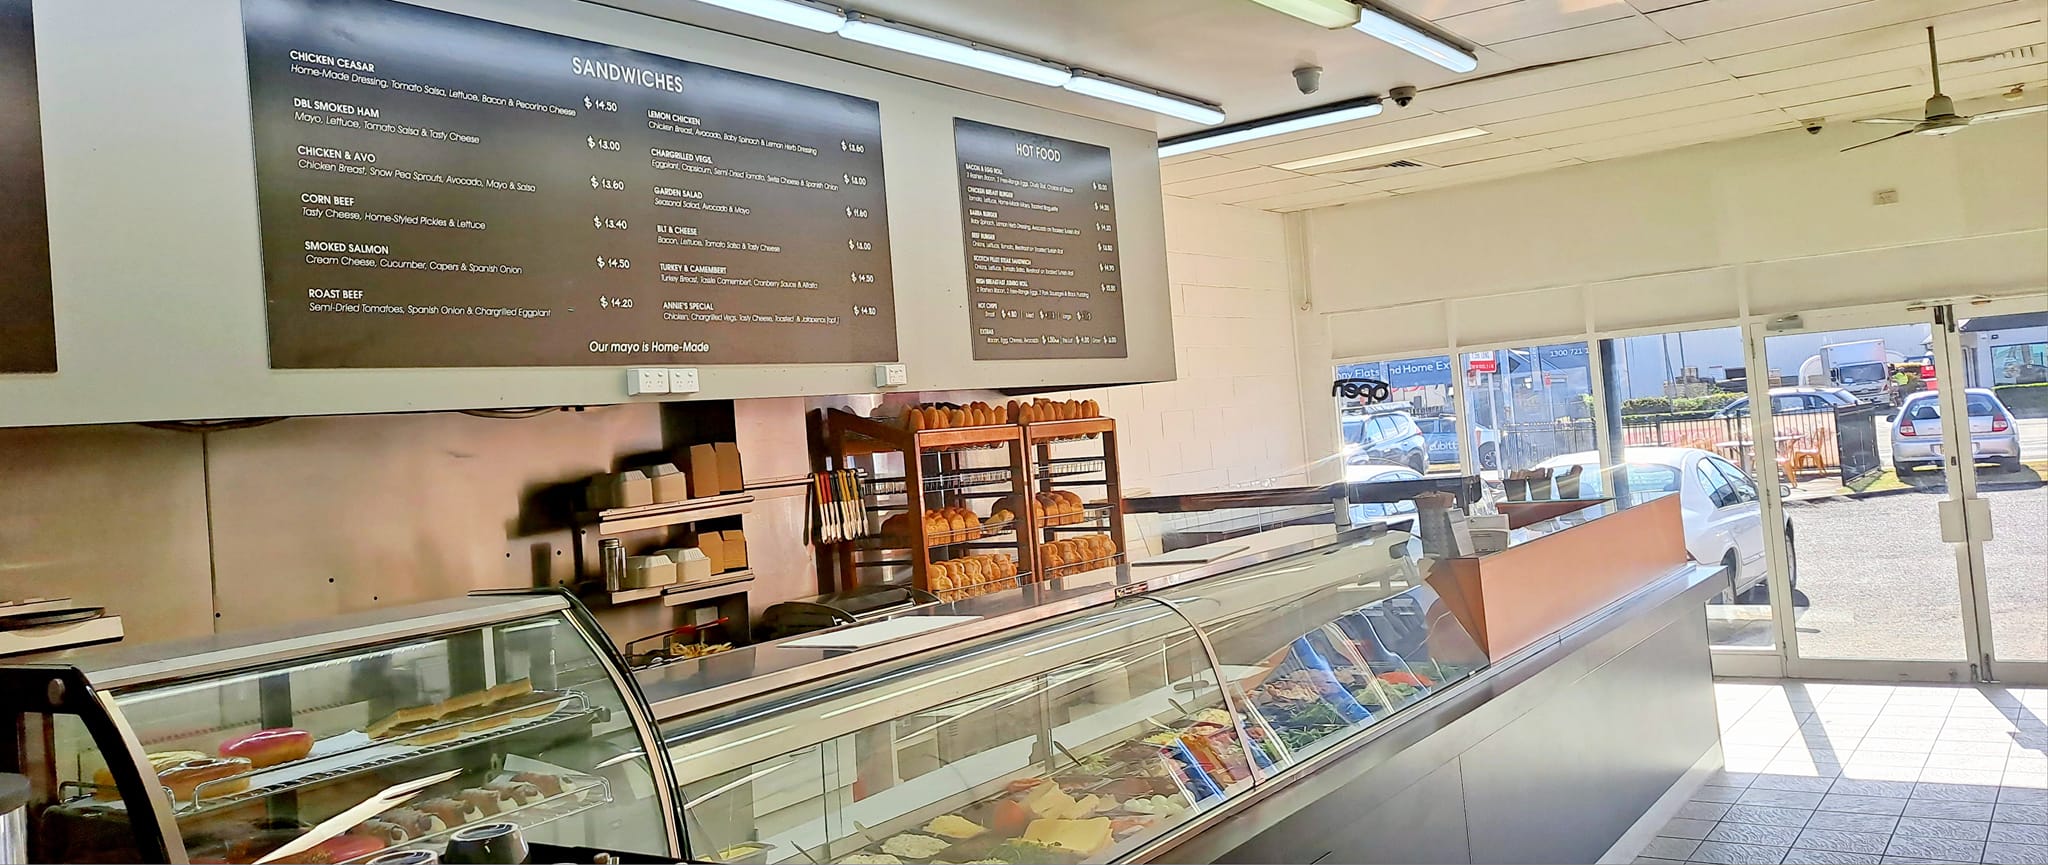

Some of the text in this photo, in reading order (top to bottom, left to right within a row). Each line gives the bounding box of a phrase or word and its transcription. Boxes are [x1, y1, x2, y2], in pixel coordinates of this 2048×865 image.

[290, 51, 375, 72] CHICKEN CEASAR
[572, 56, 683, 93] SANDWICHES
[291, 64, 576, 116] Home-Made Dressing, Tomato Salsa, Lettuce, Bacon & Pecorino Cheese
[294, 98, 379, 117] DBL SMOKED HAM
[584, 96, 617, 112] $ 14.50
[648, 110, 700, 125] LEMON CHICKEN
[295, 112, 479, 143] Mayo, Lettuce, Tomato Salsa & Tasty Cheese
[649, 121, 673, 131] Chicken
[695, 129, 722, 139] Avocado,
[724, 134, 737, 143] Baby
[766, 141, 784, 149] Lemon
[587, 136, 620, 151] $ 13.00
[841, 140, 847, 151] $
[298, 146, 375, 162] CHICKEN & AVO
[651, 149, 694, 160] CHARGRILLED
[1016, 143, 1060, 161] HOT FOOD
[299, 159, 536, 192] Chicken Breast, Snow Pea Sprouts, Avocado, Mayo & Salsa
[844, 173, 850, 184] $
[591, 176, 624, 191] $ 13.60
[824, 183, 839, 191] Onion
[654, 187, 702, 199] GARDEN SALAD
[301, 194, 354, 206] CORN BEEF
[702, 203, 728, 212] Avocado
[735, 207, 750, 215] Mayo
[846, 206, 852, 218] $
[302, 207, 486, 229] Tasty Cheese, Home-Styled Pickles & Lettuce
[594, 216, 627, 230] $ 13.40
[657, 225, 698, 236] BLT CHEESE
[305, 241, 389, 254] SMOKED SALMON
[658, 236, 678, 245] Bacon,
[705, 240, 725, 249] Tomato
[727, 242, 740, 250] Salsa
[747, 243, 759, 251] Tasty
[760, 244, 781, 252] Cheese
[848, 239, 854, 250] $
[306, 255, 523, 274] Cream Cheese, Cucumber, Capers & Spanish Onion
[597, 256, 630, 269] $ 14.50
[660, 264, 727, 274] TURKEY CAMEMBERT
[754, 279, 780, 288] Cranberry
[851, 272, 856, 283] $
[308, 289, 363, 299] ROAST BEEF
[600, 296, 632, 309] $ 14.20
[663, 302, 714, 311] ANNIE'S SPECIAL
[310, 303, 550, 318] Semi-Dried Tomatoes, Spanish Onion & Chargrilled Eggplant
[854, 305, 859, 316] $
[589, 340, 709, 354] Our mayo is Home-Made
[1550, 350, 1567, 358] 1300
[1354, 368, 1379, 377] Flats
[1403, 364, 1433, 373] Home
